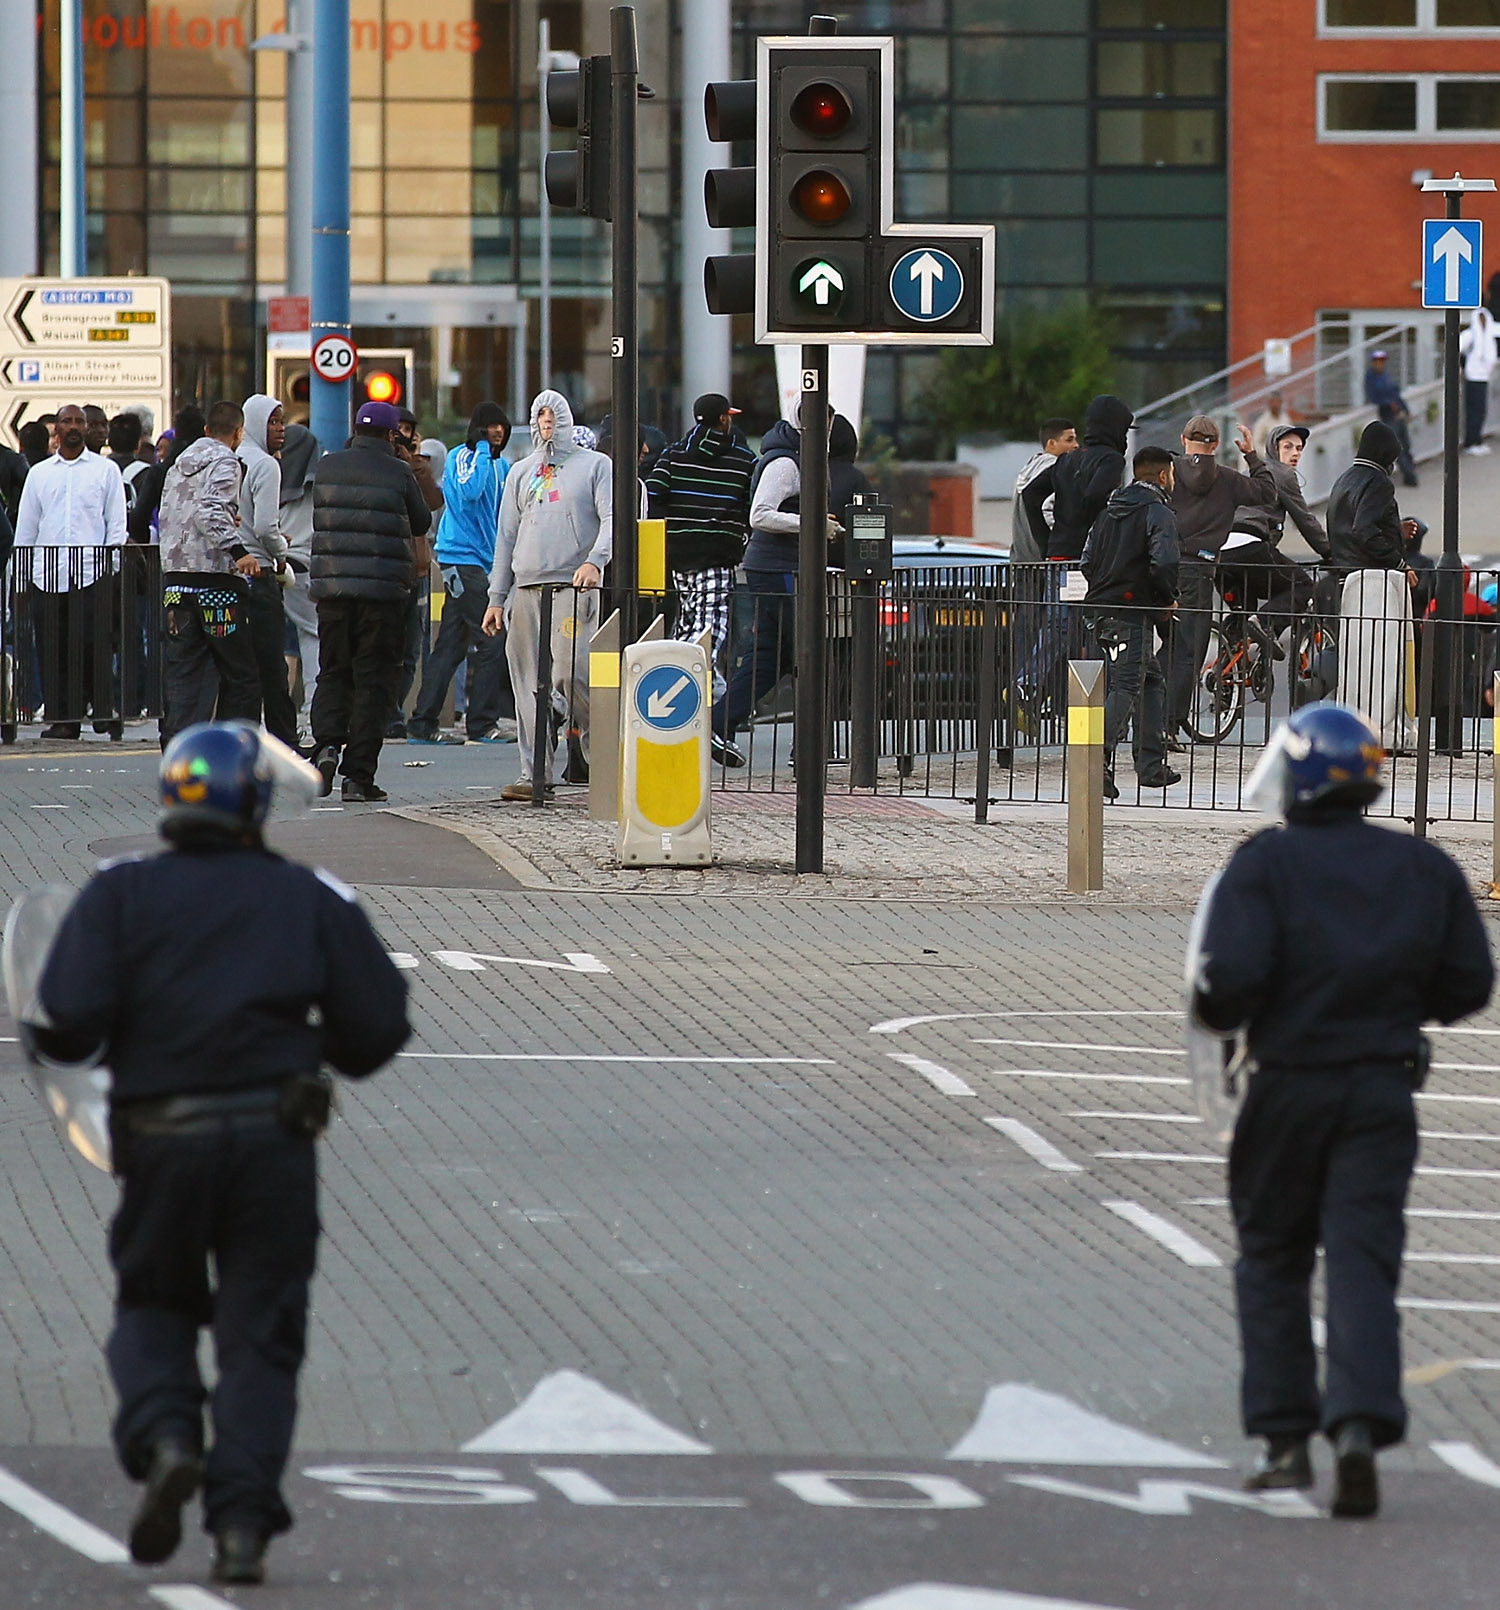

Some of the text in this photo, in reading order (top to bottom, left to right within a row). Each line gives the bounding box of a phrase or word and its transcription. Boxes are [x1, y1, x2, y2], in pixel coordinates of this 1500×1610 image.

[319, 349, 351, 367] 20
[803, 371, 815, 390] 6
[303, 1463, 1330, 1520] SLOW
